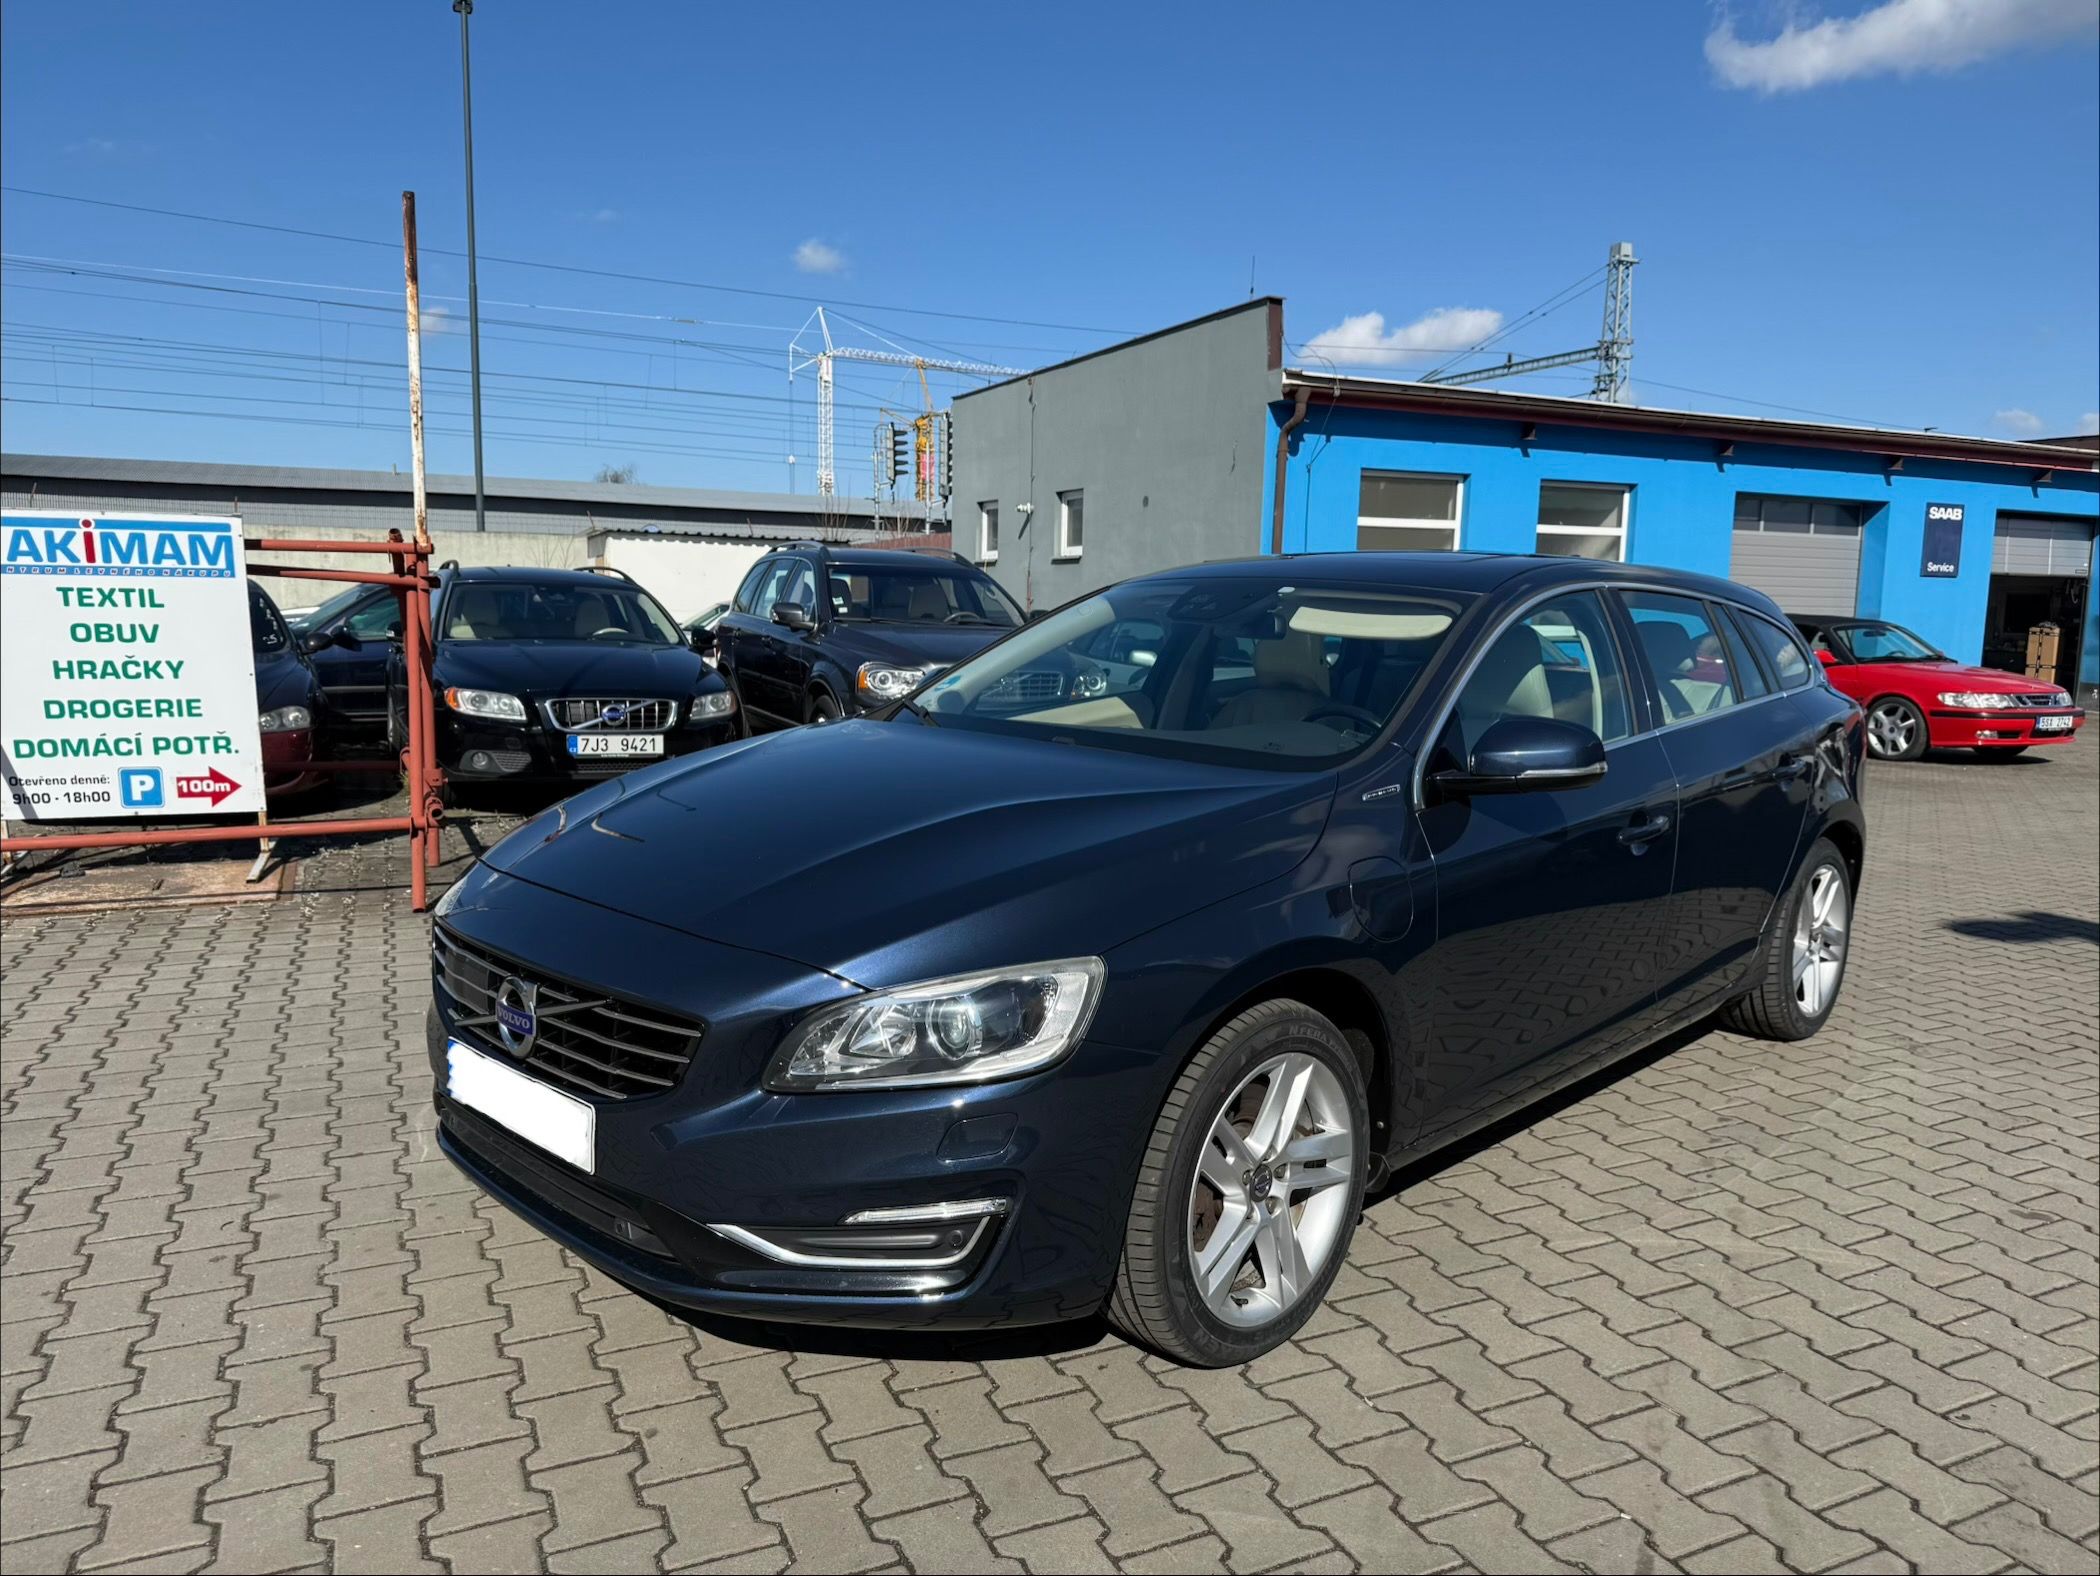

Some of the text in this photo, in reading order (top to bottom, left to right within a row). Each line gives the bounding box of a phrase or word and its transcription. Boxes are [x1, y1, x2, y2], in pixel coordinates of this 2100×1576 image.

[1929, 506, 1962, 520] SAAB
[1927, 562, 1954, 572] Service
[56, 587, 165, 608] TEXTIL
[70, 623, 159, 643] OBUV
[53, 655, 184, 679] HRAČKY
[44, 699, 203, 719] DROGERIE
[14, 731, 239, 758] DOMÁCÍ POTŘ.
[581, 738, 656, 752] 7J3 9421
[9, 775, 110, 786] Otevřeno denně:
[178, 780, 231, 793] 100m
[13, 793, 51, 804] 9h00
[64, 791, 111, 803] 18h00
[497, 1005, 531, 1029] VOLVO
